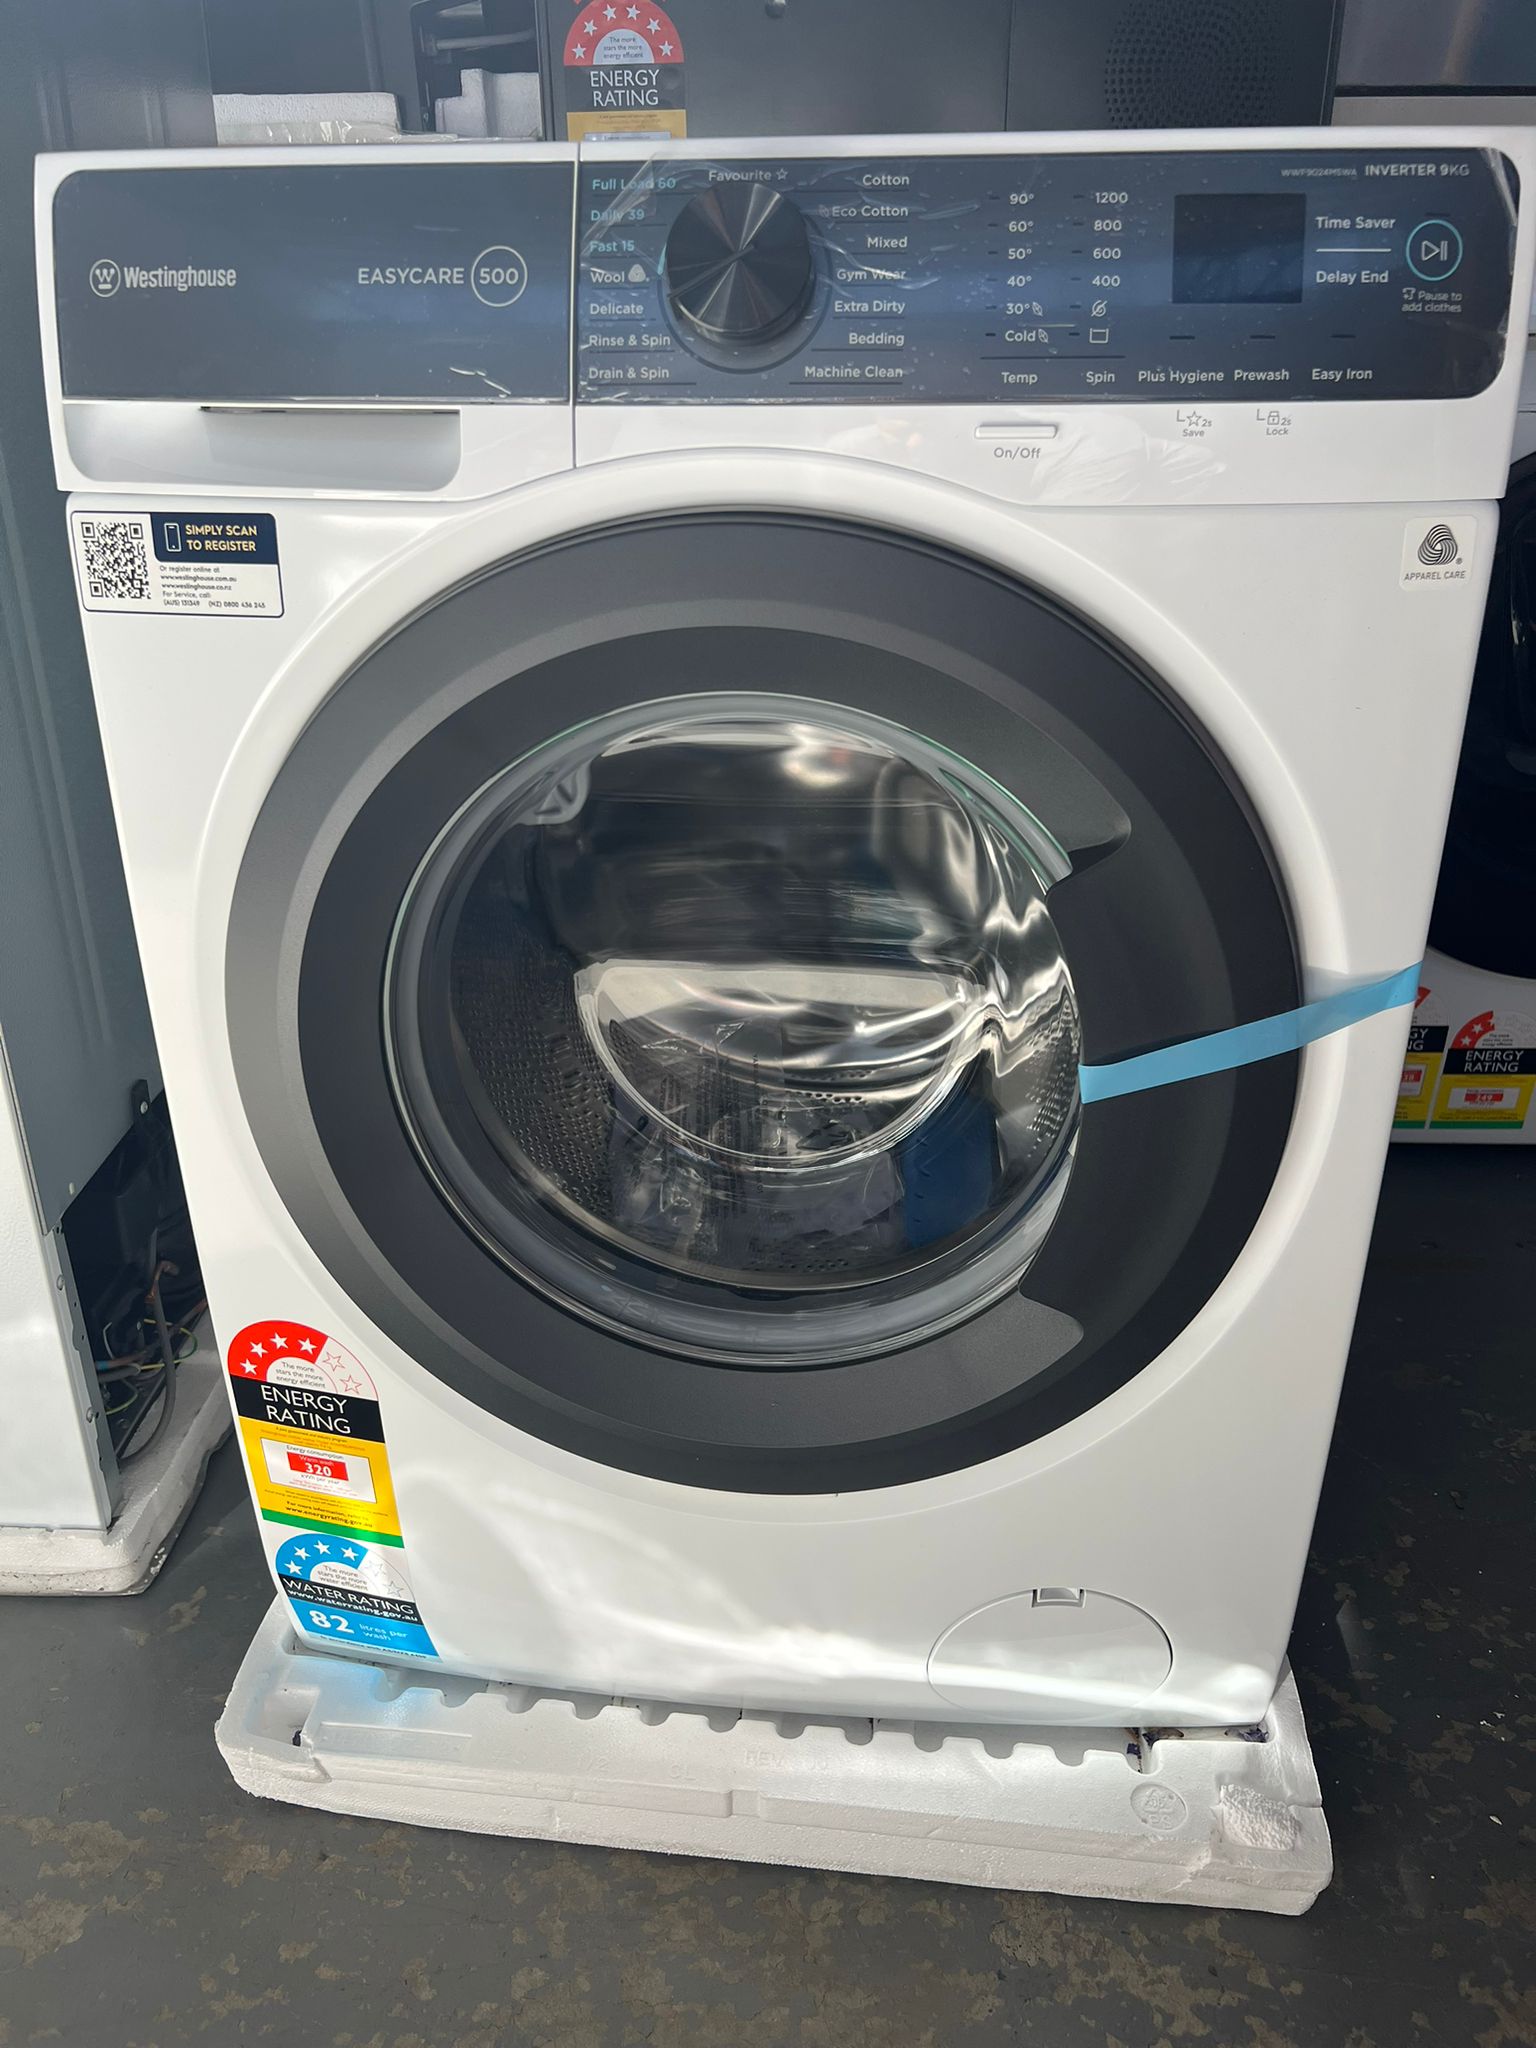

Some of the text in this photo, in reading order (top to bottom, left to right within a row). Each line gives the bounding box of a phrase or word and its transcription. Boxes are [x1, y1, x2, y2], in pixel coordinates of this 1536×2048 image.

[590, 69, 660, 87] ENERGY
[593, 89, 659, 107] RATING
[708, 169, 772, 181] Favourite
[1365, 162, 1470, 177] INVERTER 9KG
[592, 177, 676, 190] Full Load 60
[862, 174, 910, 186] Cotton
[1095, 192, 1129, 204] 1200
[628, 208, 645, 220] 39
[831, 205, 909, 217] Eco Cotton
[1094, 219, 1122, 231] 800
[1315, 216, 1396, 229] Time Saver
[589, 240, 635, 252] Fast 15
[867, 236, 908, 248] Mixed
[1093, 248, 1121, 260] 600
[123, 265, 237, 292] Westinghouse
[357, 267, 519, 285] EASYCARE 500
[590, 271, 625, 283] Wool
[836, 268, 867, 281] Gym
[1092, 275, 1121, 287] 400
[1316, 270, 1389, 285] Delay End
[1418, 290, 1463, 301] Pause to
[590, 303, 644, 315] Delicate
[834, 300, 906, 314] Extra Dirty
[1401, 302, 1423, 312] add
[589, 334, 671, 348] Rinse & Spin
[848, 332, 905, 346] Bedding
[1005, 330, 1036, 342] Cold
[589, 367, 670, 380] Drain & Spin
[804, 365, 903, 378] Machine Clean
[1138, 369, 1225, 384] Plus Hygiene
[1234, 369, 1290, 382] Prewash
[1311, 367, 1373, 382] Easy Iron
[1001, 372, 1038, 385] Temp
[1086, 371, 1116, 386] Spin
[1183, 428, 1205, 437] Save
[1266, 427, 1289, 436] Lock
[993, 446, 1041, 460] On/Off
[185, 524, 258, 536] SIMPLY SCAN
[186, 539, 257, 552] TO REGISTER
[1404, 570, 1466, 580] APPAREL CARE
[1465, 1050, 1524, 1062] ENERGY
[1464, 1062, 1519, 1073] RATING
[281, 1361, 295, 1369] The
[276, 1376, 326, 1388] energy efficient
[305, 1373, 323, 1381] more
[260, 1384, 348, 1414] ENERGY
[266, 1405, 351, 1434] RATING
[286, 1444, 344, 1460] Energy consumption
[304, 1462, 332, 1477] 320
[317, 1570, 368, 1585] stars the more
[323, 1565, 359, 1577] The more
[320, 1577, 369, 1591] water efficient
[282, 1577, 414, 1615] WATER RATING
[287, 1589, 418, 1621] www.waterrating.gov.au
[309, 1609, 355, 1634] 82
[359, 1623, 408, 1638] litres per
[363, 1631, 391, 1641] wash
